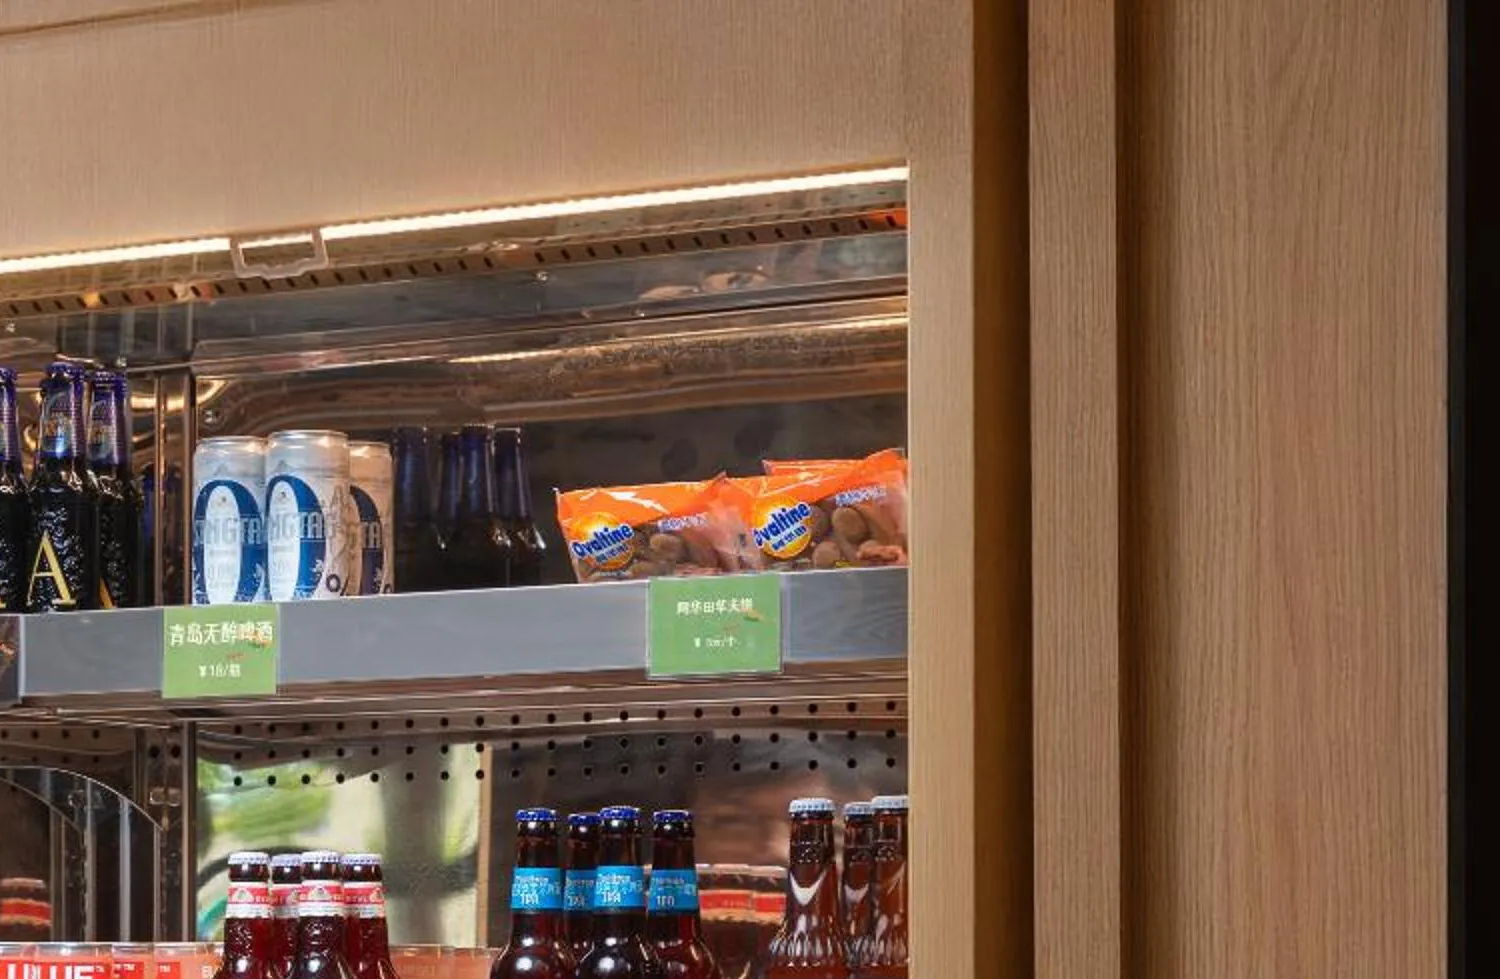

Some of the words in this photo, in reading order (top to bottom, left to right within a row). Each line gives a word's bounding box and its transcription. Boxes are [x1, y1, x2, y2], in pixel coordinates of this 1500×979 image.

[571, 524, 635, 559] Ovaltine
[753, 502, 812, 547] Ovaltine
[27, 531, 77, 606] A
